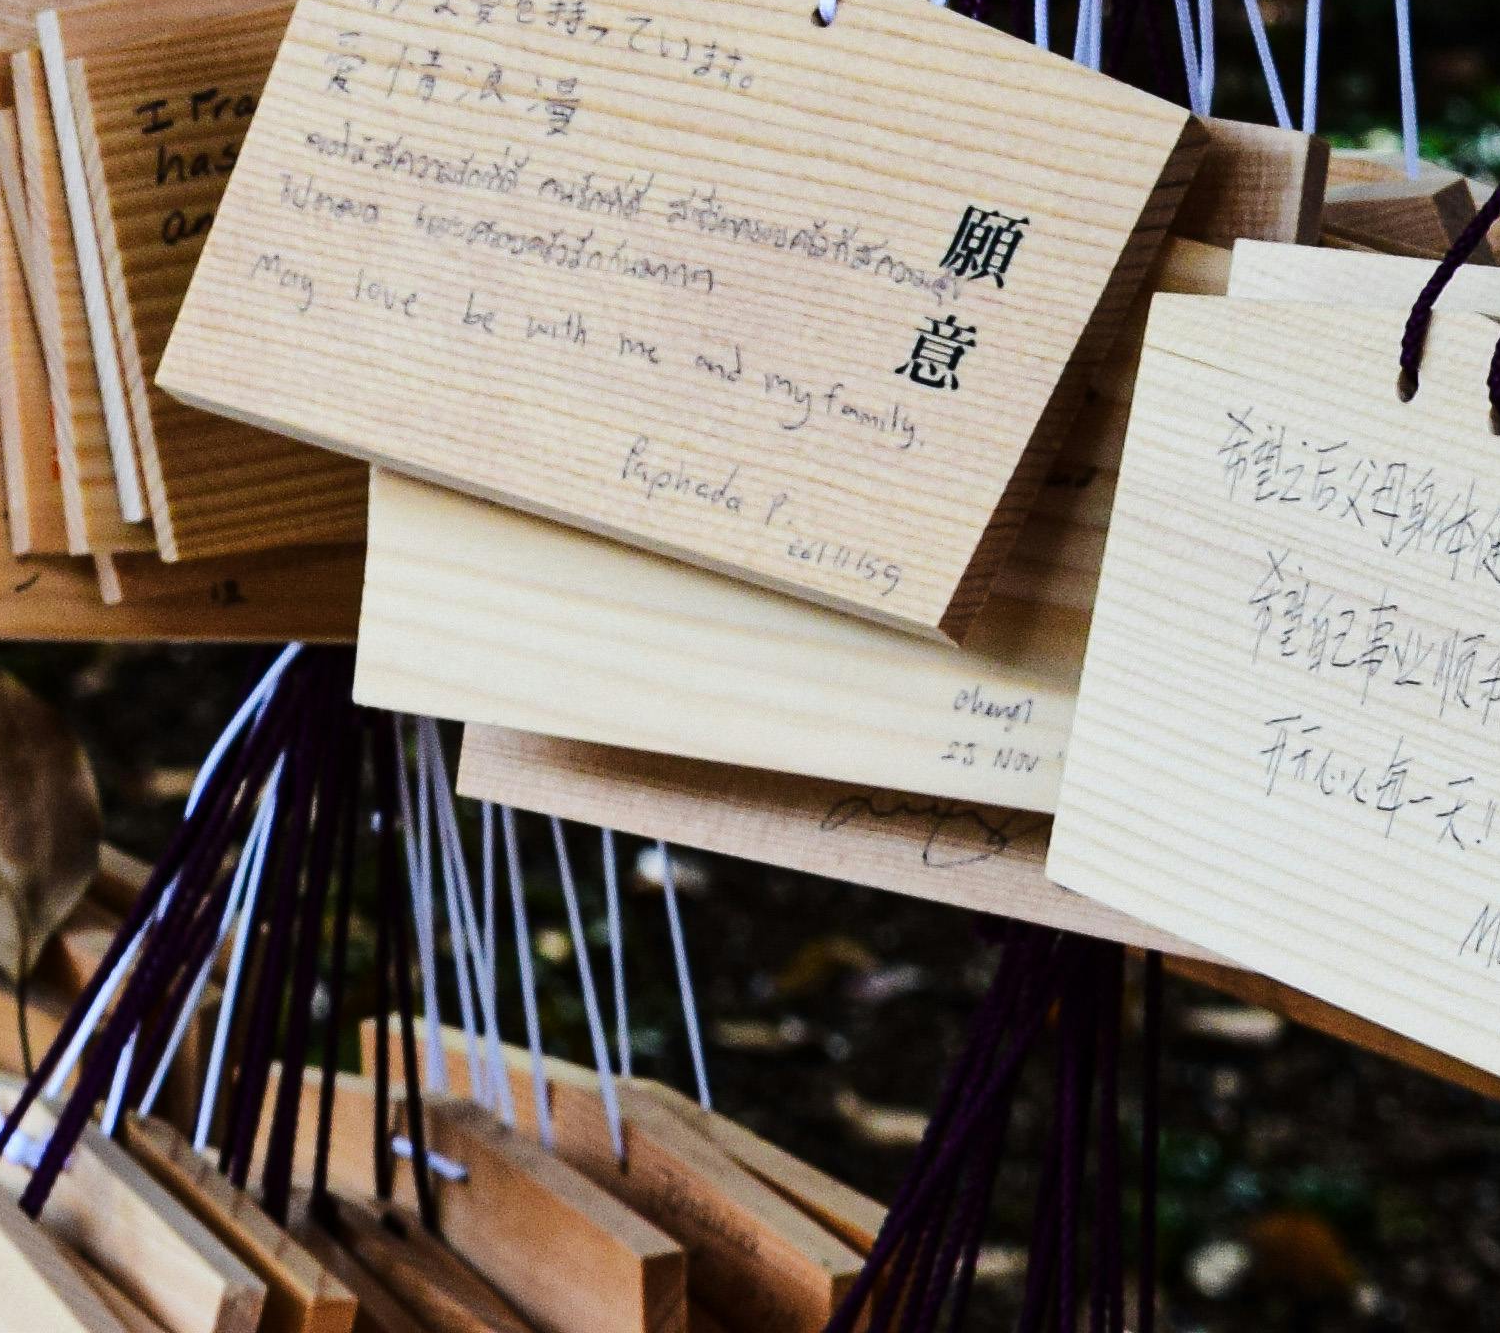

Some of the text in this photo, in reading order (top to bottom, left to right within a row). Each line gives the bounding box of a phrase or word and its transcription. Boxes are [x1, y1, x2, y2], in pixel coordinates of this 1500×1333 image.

[136, 99, 175, 136] I
[155, 142, 239, 186] has
[251, 252, 316, 315] May
[354, 267, 419, 319] love
[462, 291, 498, 334] be
[525, 310, 589, 348] with
[618, 331, 662, 364] me
[694, 344, 744, 385] and
[763, 371, 815, 431] my
[893, 203, 1031, 394] 願意
